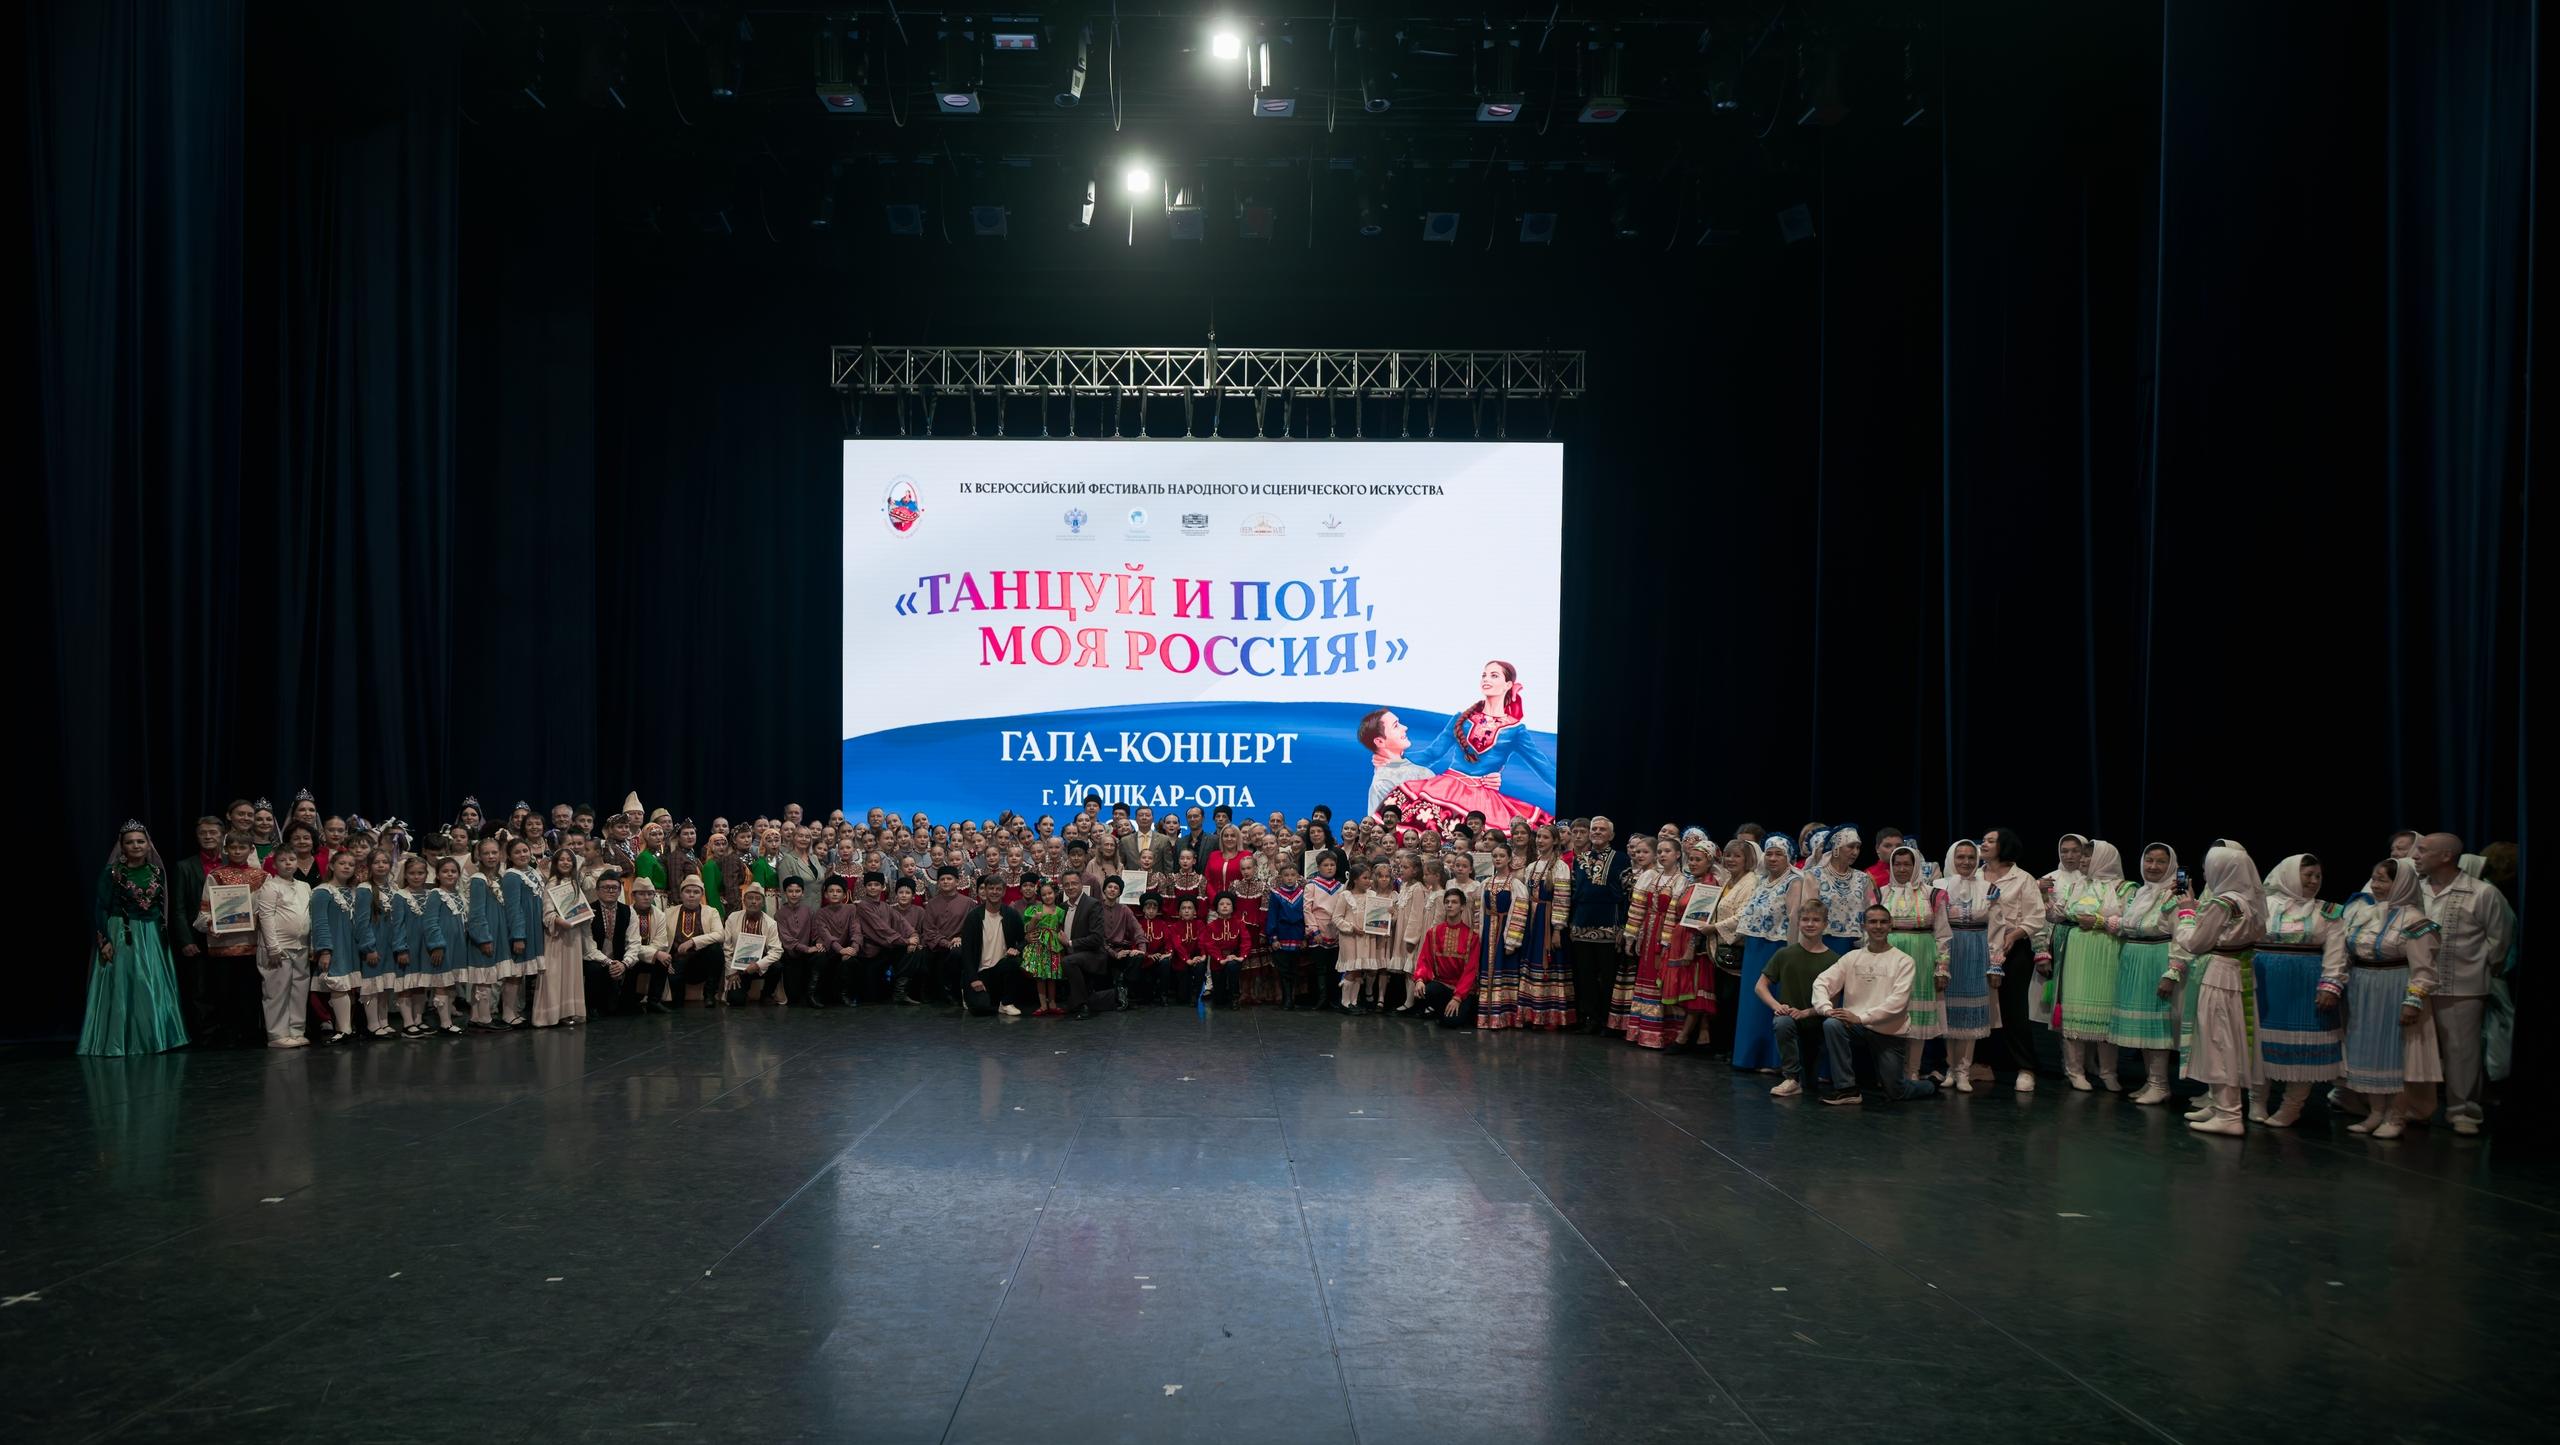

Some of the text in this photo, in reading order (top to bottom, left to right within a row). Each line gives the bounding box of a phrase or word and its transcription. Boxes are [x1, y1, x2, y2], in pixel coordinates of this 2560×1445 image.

[959, 481, 1444, 497] IX ВСЕРОССИЙСКИЙ ФЕСТИВАЛЬ НАРОДНОГО И СЦЕНИЧЕСКОГО ИСКУССТВА
[895, 563, 1374, 621] «ТАНЦУЙ И ПОЙ,
[978, 625, 1409, 677] МОЯ РОССИЯ!»
[1000, 730, 1298, 768] ГАЛА-КОНЦЕРТ
[1042, 789, 1058, 806] г.
